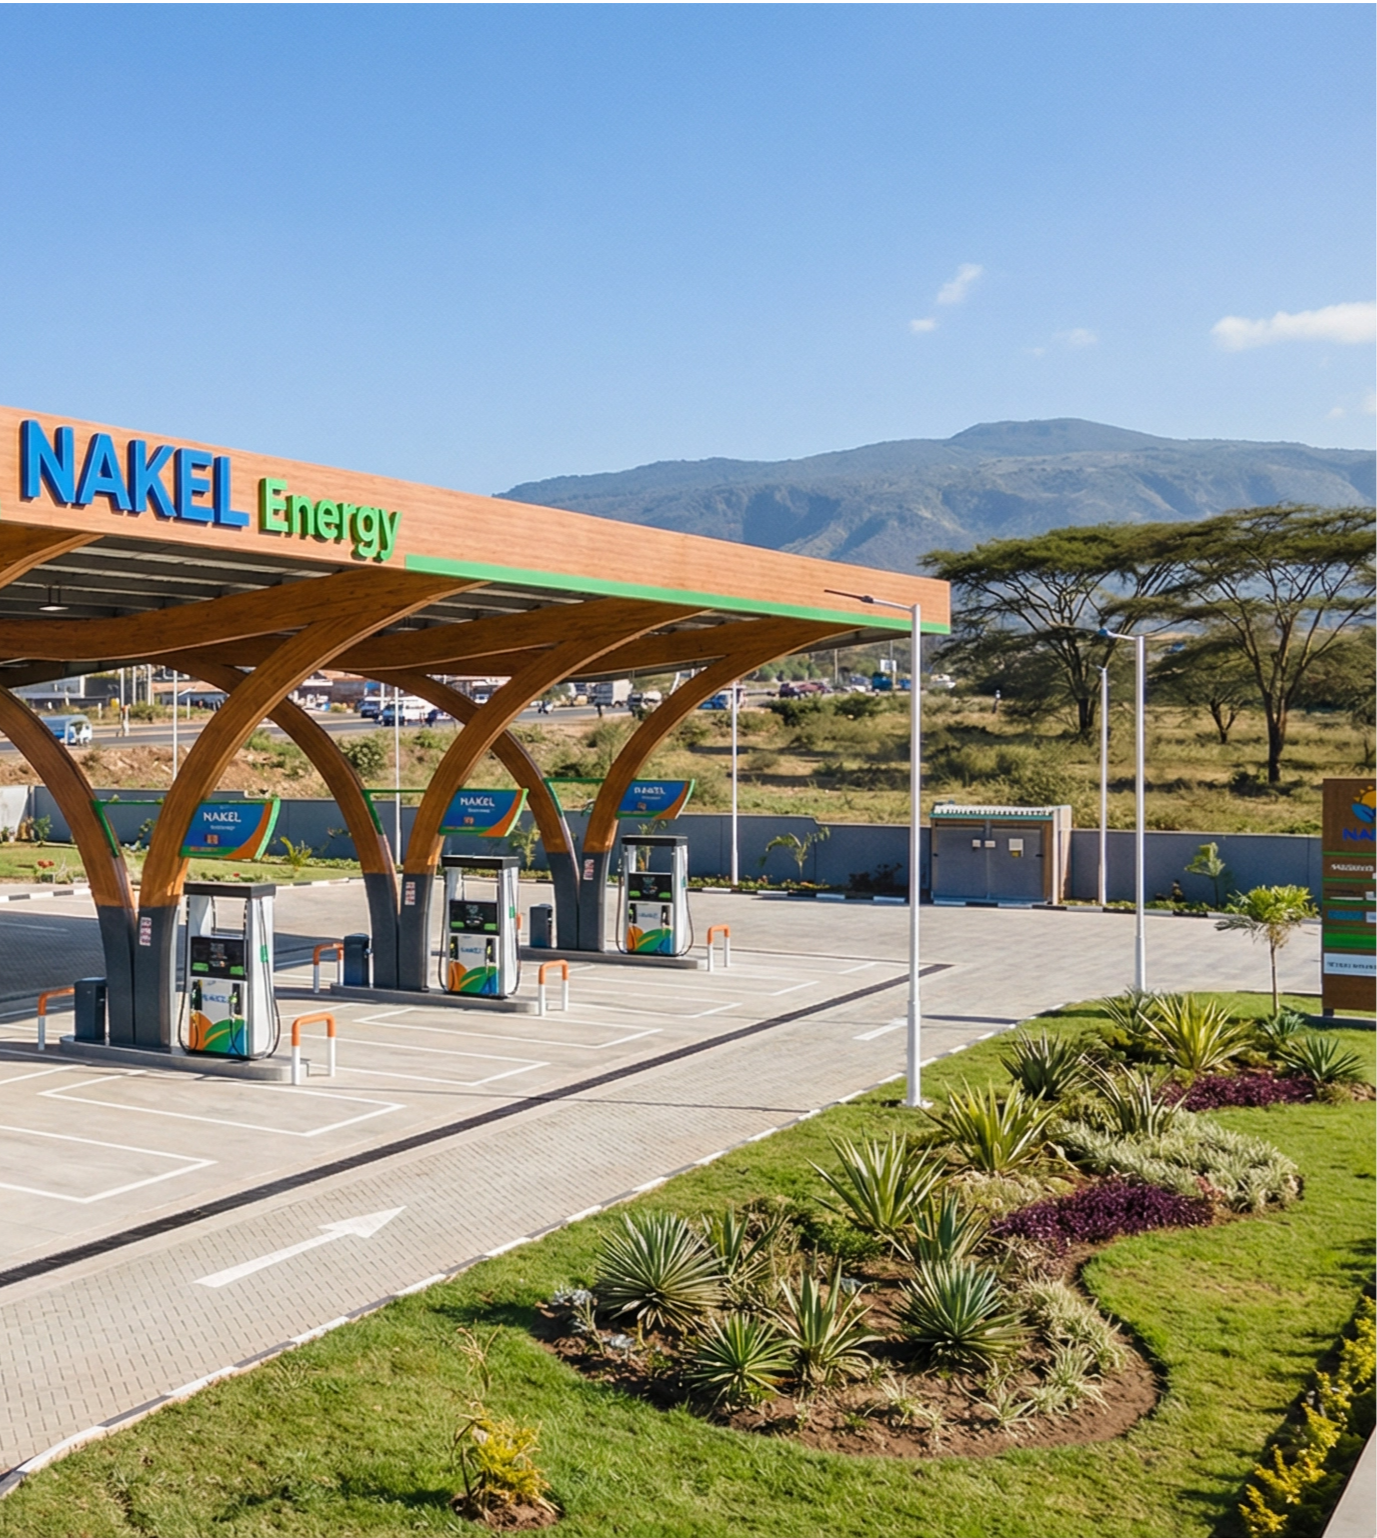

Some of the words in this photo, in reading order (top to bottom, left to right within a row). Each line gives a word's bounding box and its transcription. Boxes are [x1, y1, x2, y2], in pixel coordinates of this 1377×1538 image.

[20, 419, 250, 528] NAKEL
[259, 477, 402, 562] Energy
[203, 812, 242, 823] NAKEL
